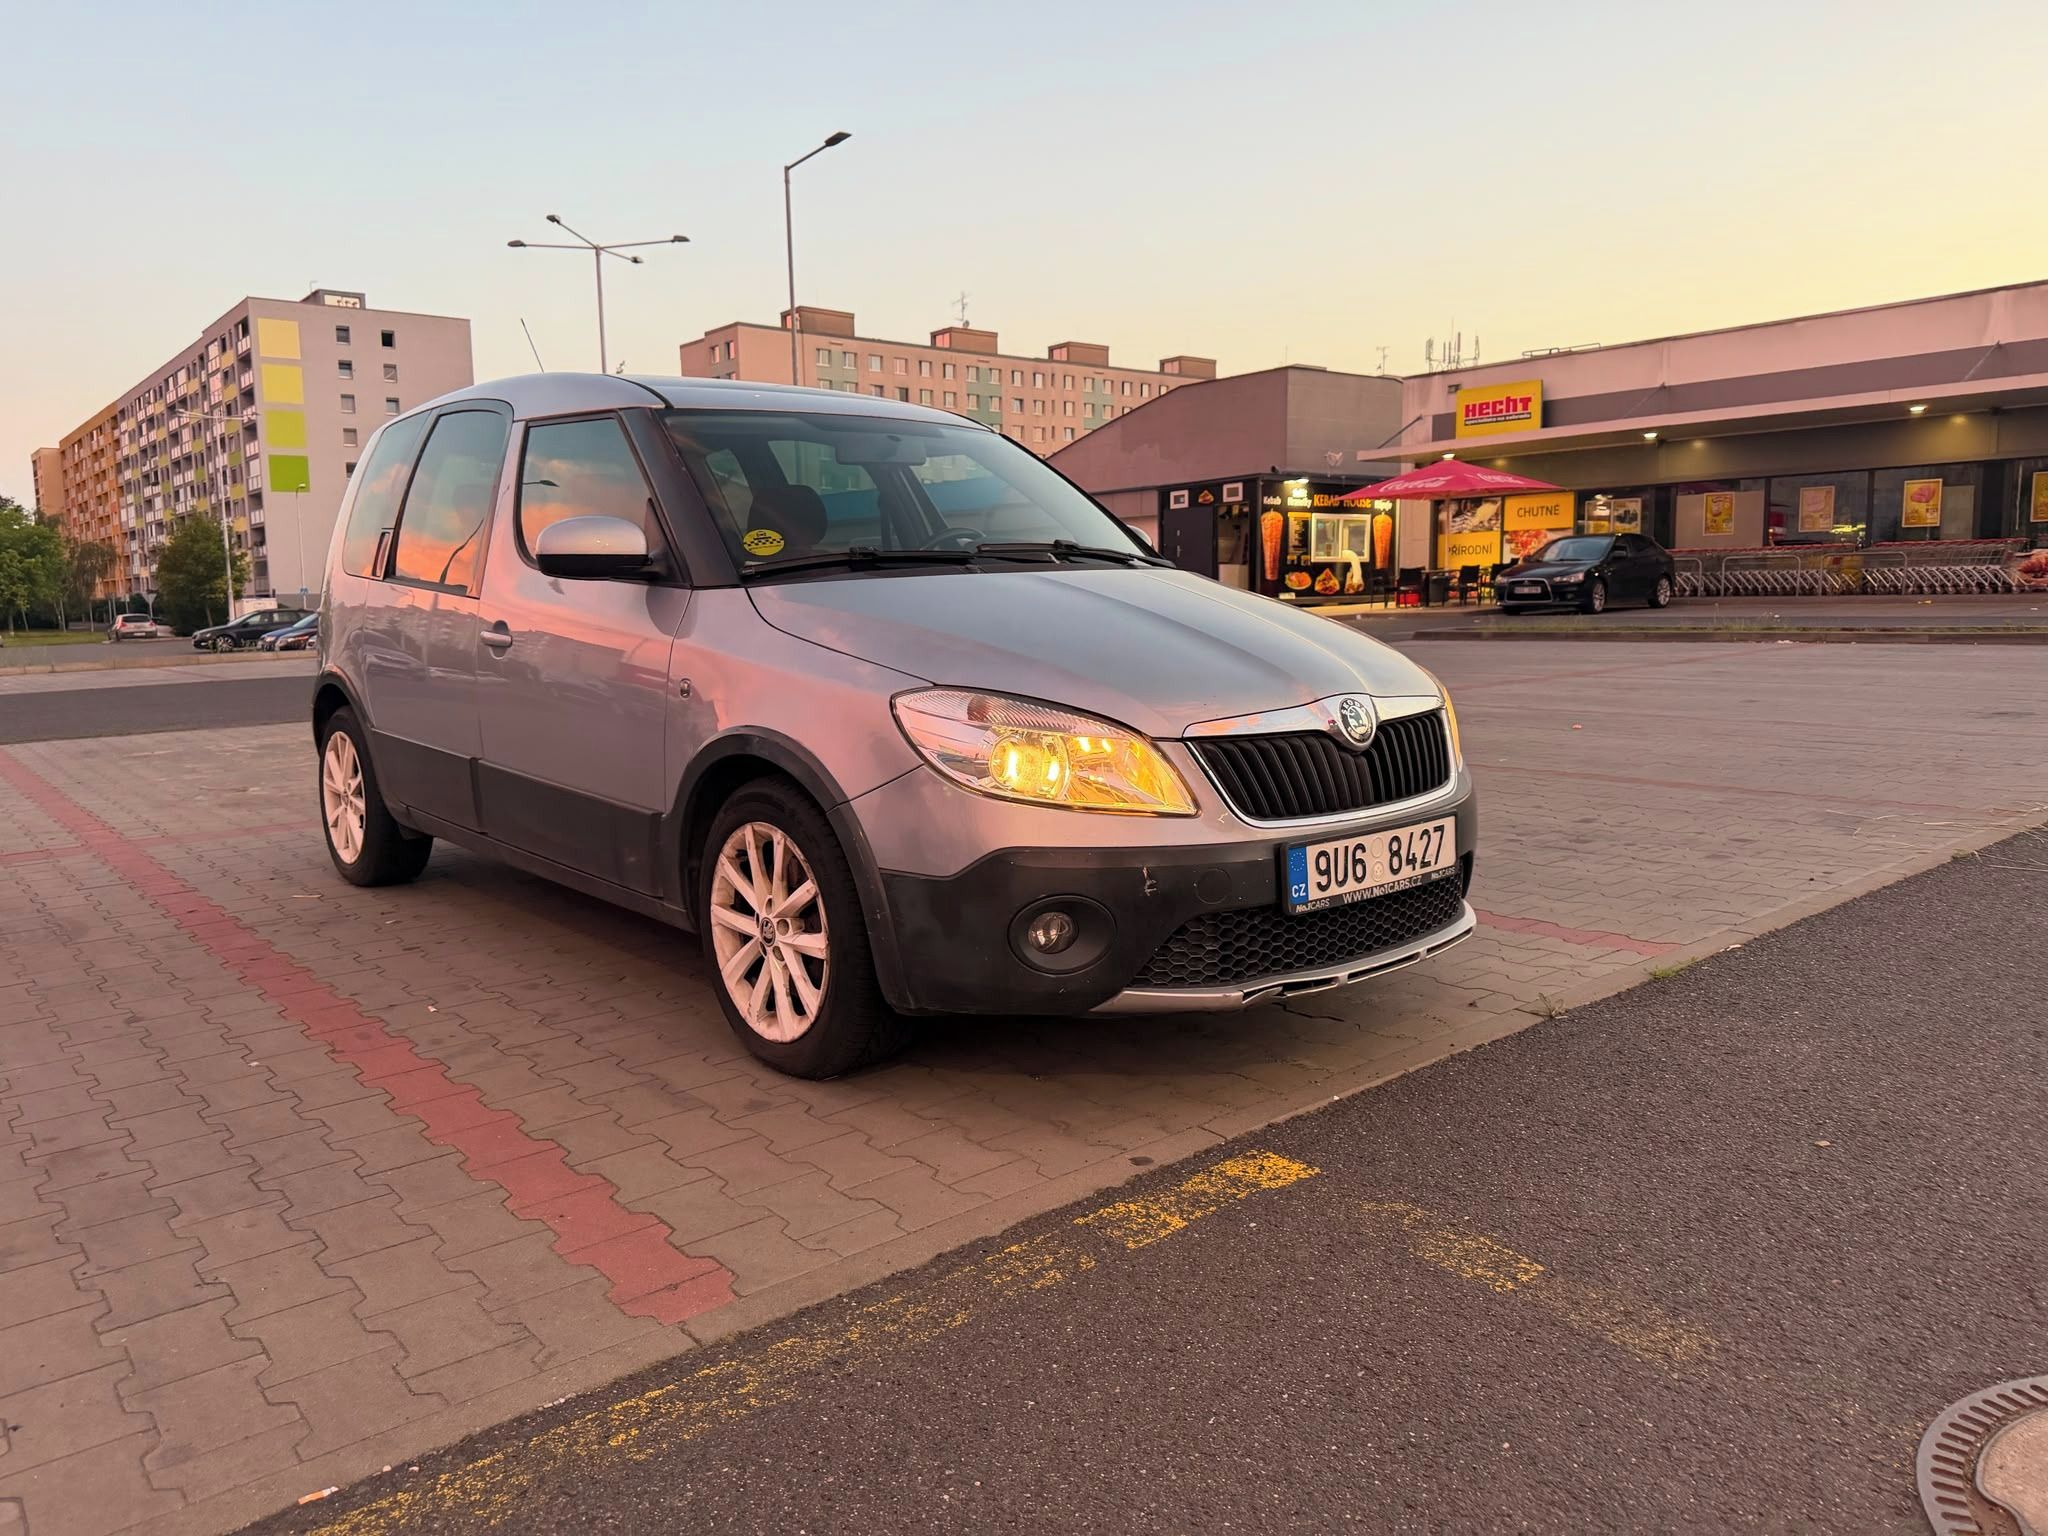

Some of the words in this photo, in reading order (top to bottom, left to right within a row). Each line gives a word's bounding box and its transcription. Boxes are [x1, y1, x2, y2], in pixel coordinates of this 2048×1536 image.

[1315, 843, 1367, 892] 9U6
[1388, 824, 1445, 876] 8427
[1291, 883, 1307, 898] CZ
